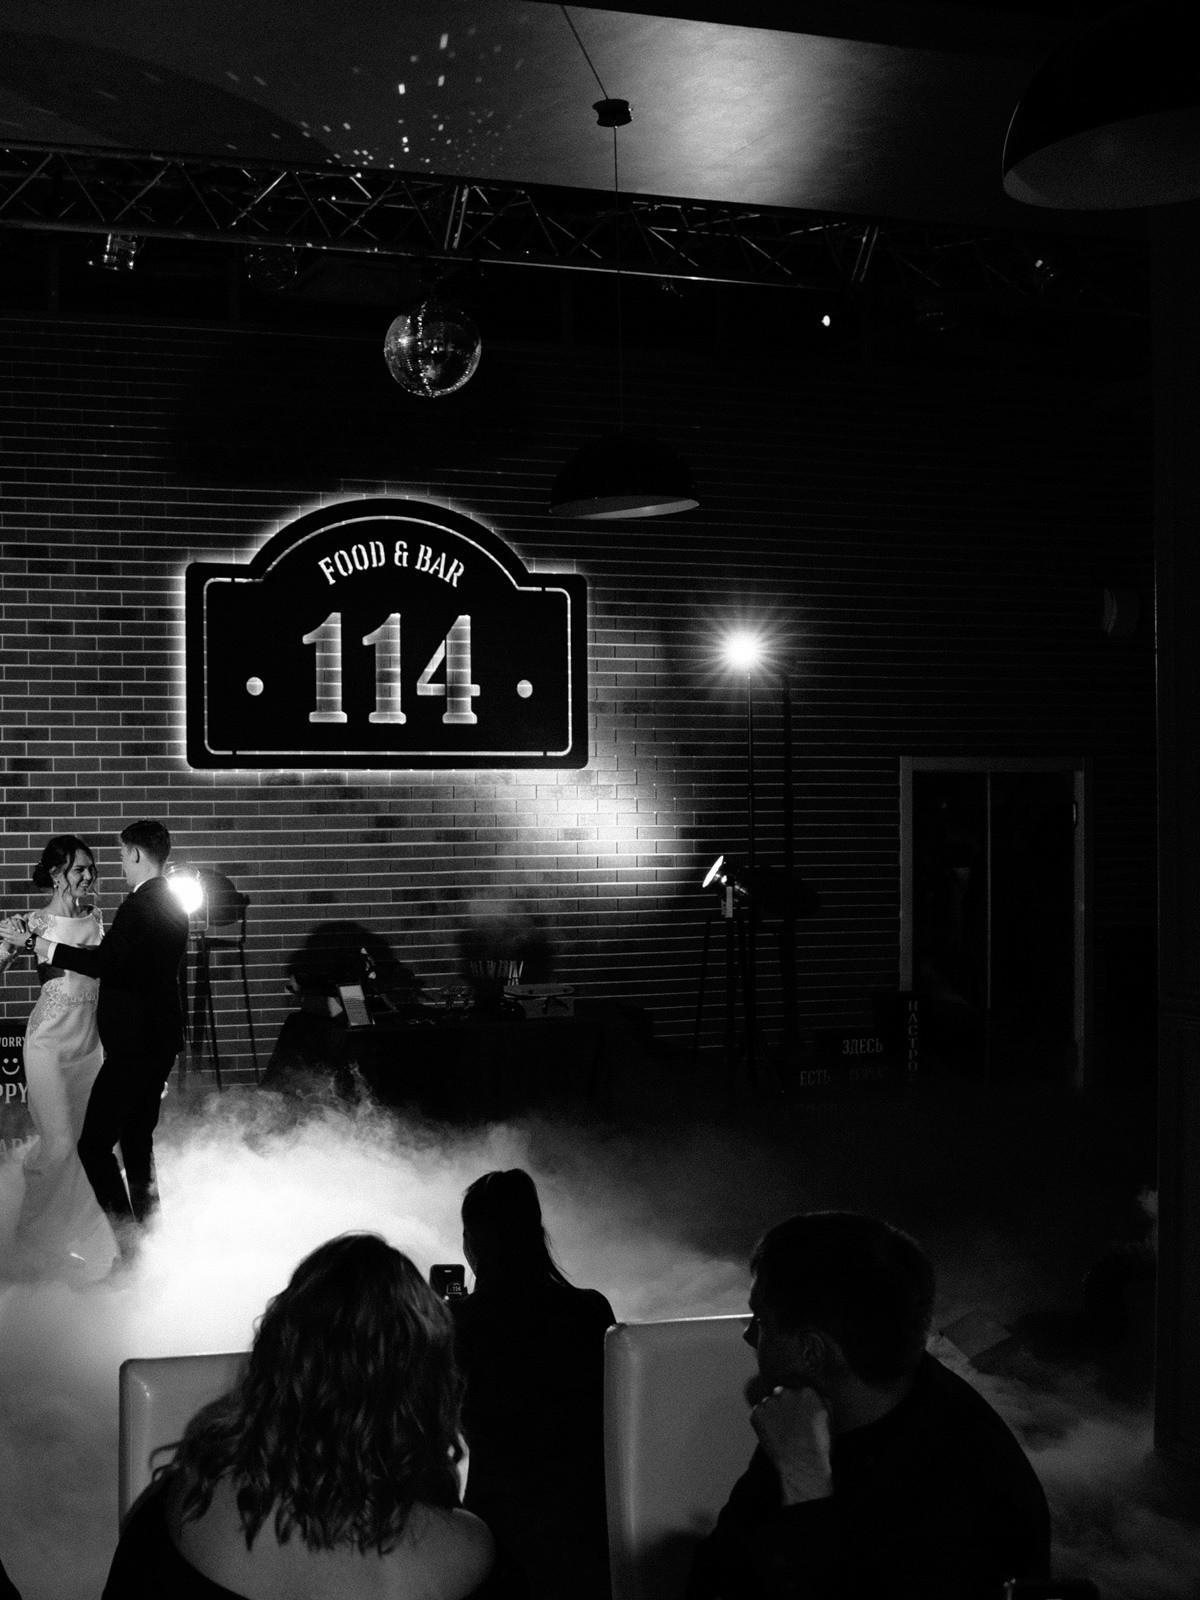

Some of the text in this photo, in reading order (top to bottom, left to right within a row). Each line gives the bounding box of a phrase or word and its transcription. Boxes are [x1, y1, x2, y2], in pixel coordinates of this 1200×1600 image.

[318, 540, 465, 588] FOOD & BAR
[302, 612, 480, 724] 114
[841, 1037, 883, 1056] ЗДЕСЬ
[800, 1068, 831, 1087] ЕСТЬ
